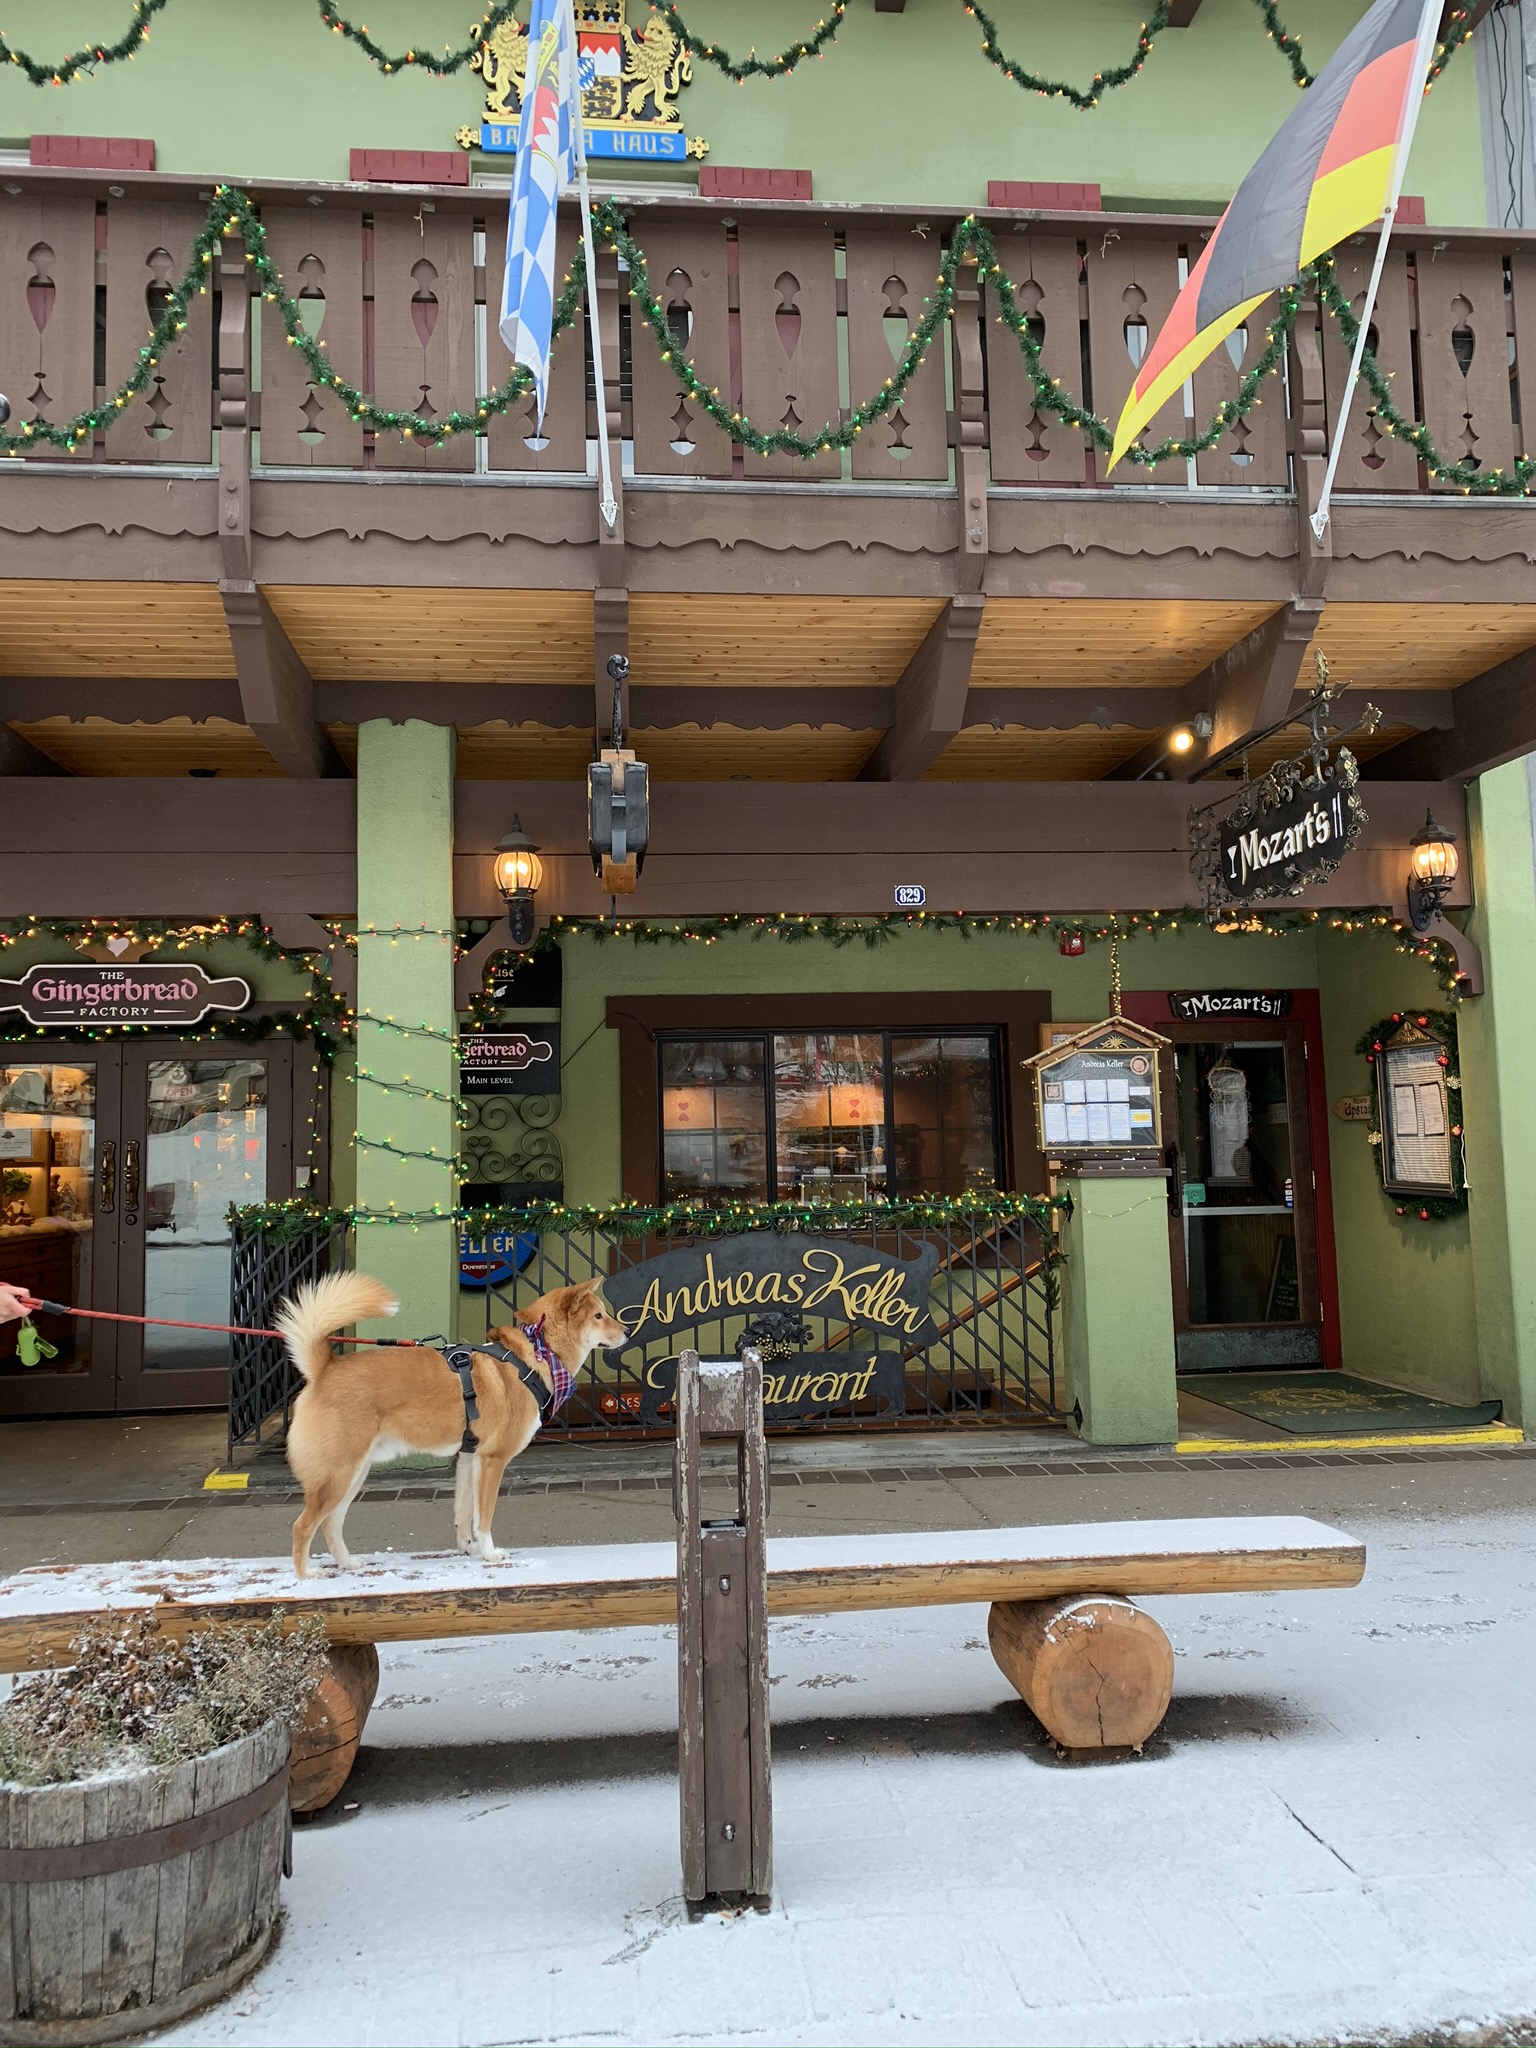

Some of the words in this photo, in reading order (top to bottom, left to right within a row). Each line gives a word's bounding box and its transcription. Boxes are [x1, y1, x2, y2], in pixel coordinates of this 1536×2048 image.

[612, 132, 676, 155] HAUS
[1239, 802, 1331, 886] Mozart's
[899, 888, 921, 903] 829
[99, 971, 125, 980] THE
[32, 978, 198, 1006] Gingerbread
[79, 1007, 150, 1017] FACTORY
[1190, 995, 1272, 1019] Mozart's
[463, 1042, 527, 1056] erbread
[166, 1086, 193, 1097] OPEN
[616, 1252, 805, 1338] Andreas
[802, 1249, 930, 1334] Keller
